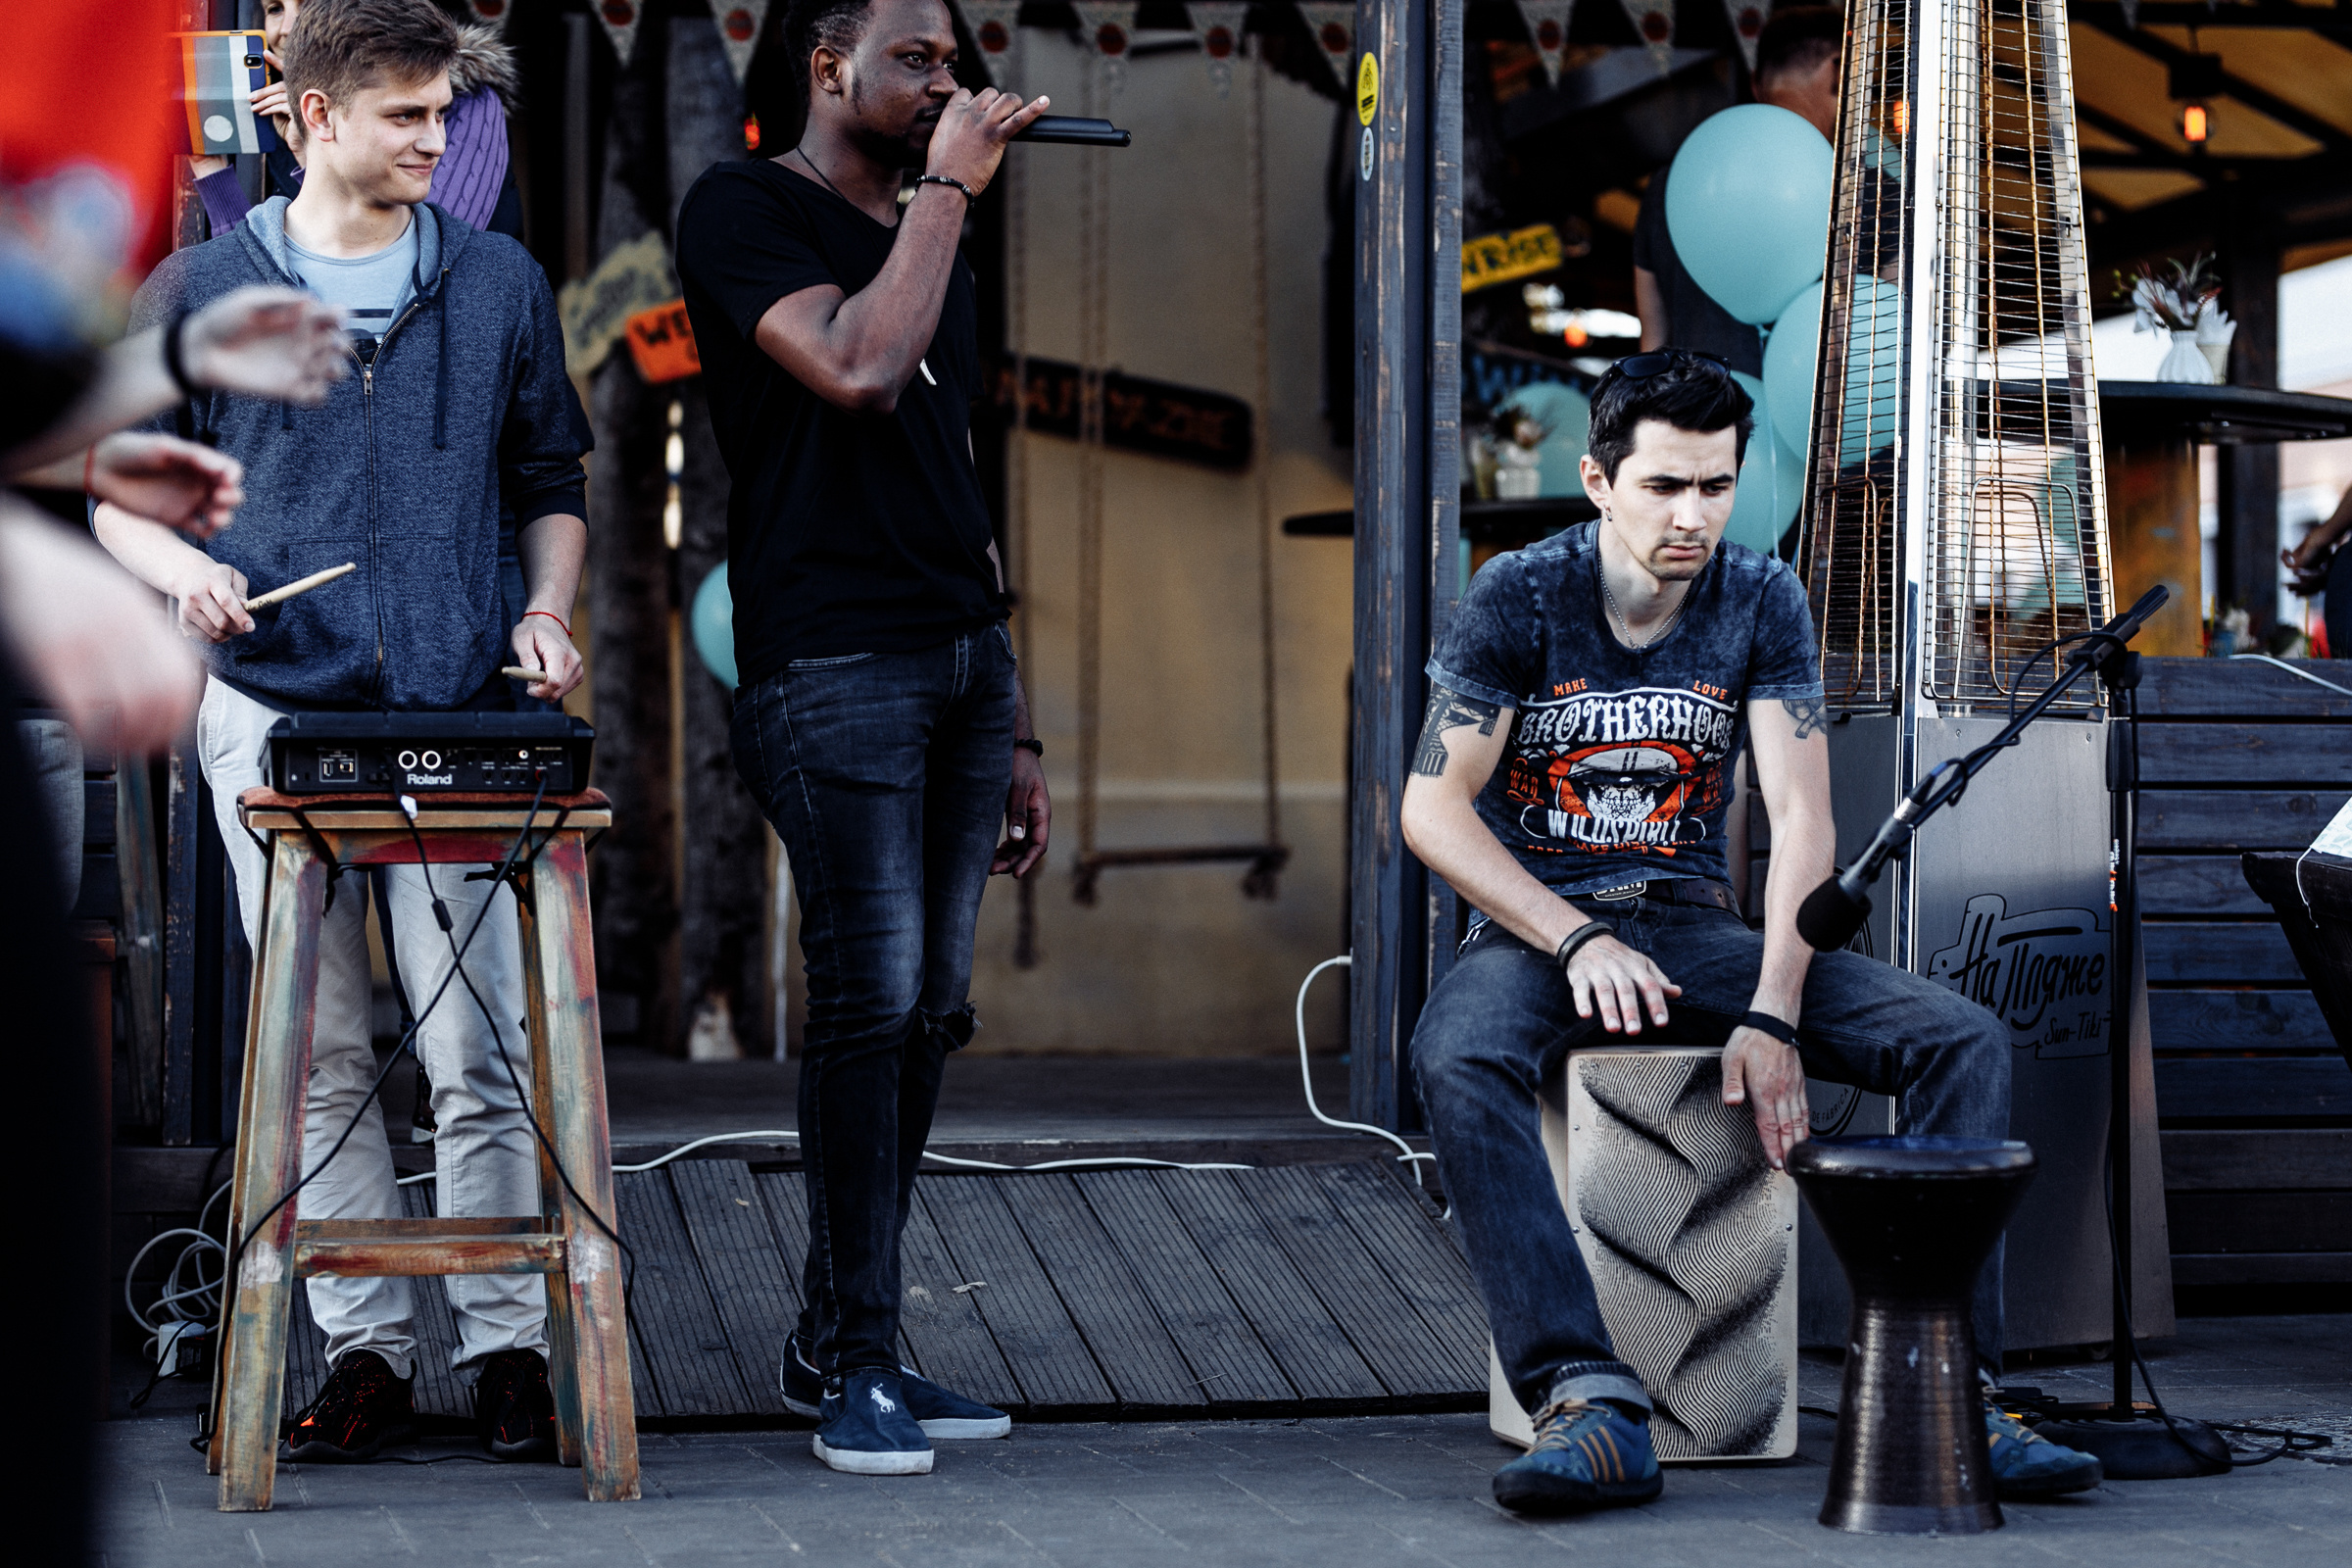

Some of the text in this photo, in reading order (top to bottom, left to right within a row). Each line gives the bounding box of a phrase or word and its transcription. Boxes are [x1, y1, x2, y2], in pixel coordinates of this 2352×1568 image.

[1553, 678, 1728, 700] MAKE LOVE
[407, 773, 453, 785] Roland
